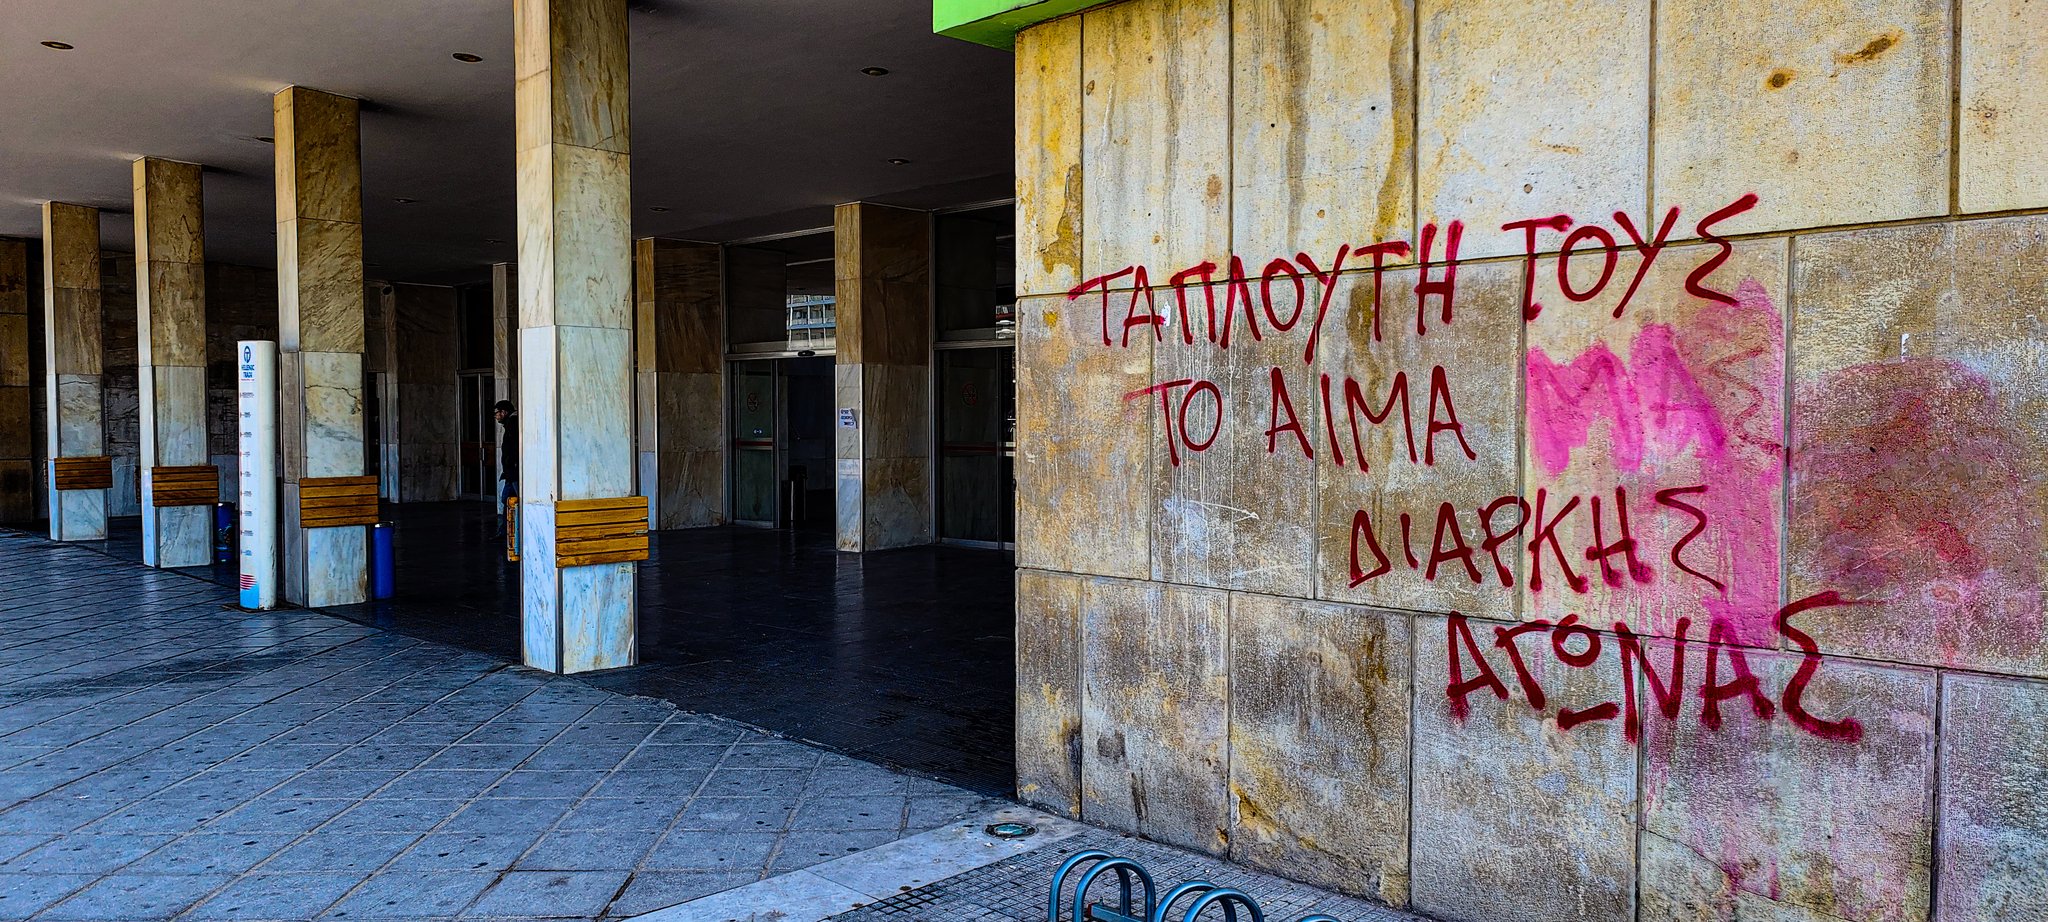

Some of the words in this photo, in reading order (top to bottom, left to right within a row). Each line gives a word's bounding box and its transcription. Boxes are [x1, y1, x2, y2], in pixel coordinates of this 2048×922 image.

[1502, 192, 1760, 322] ΤΟΥΣ
[1123, 378, 1223, 467] ΤΟ
[1266, 364, 1477, 474] ΑΙΜΑ
[1348, 485, 1726, 591] ΔΙΑΡΚΗΣ
